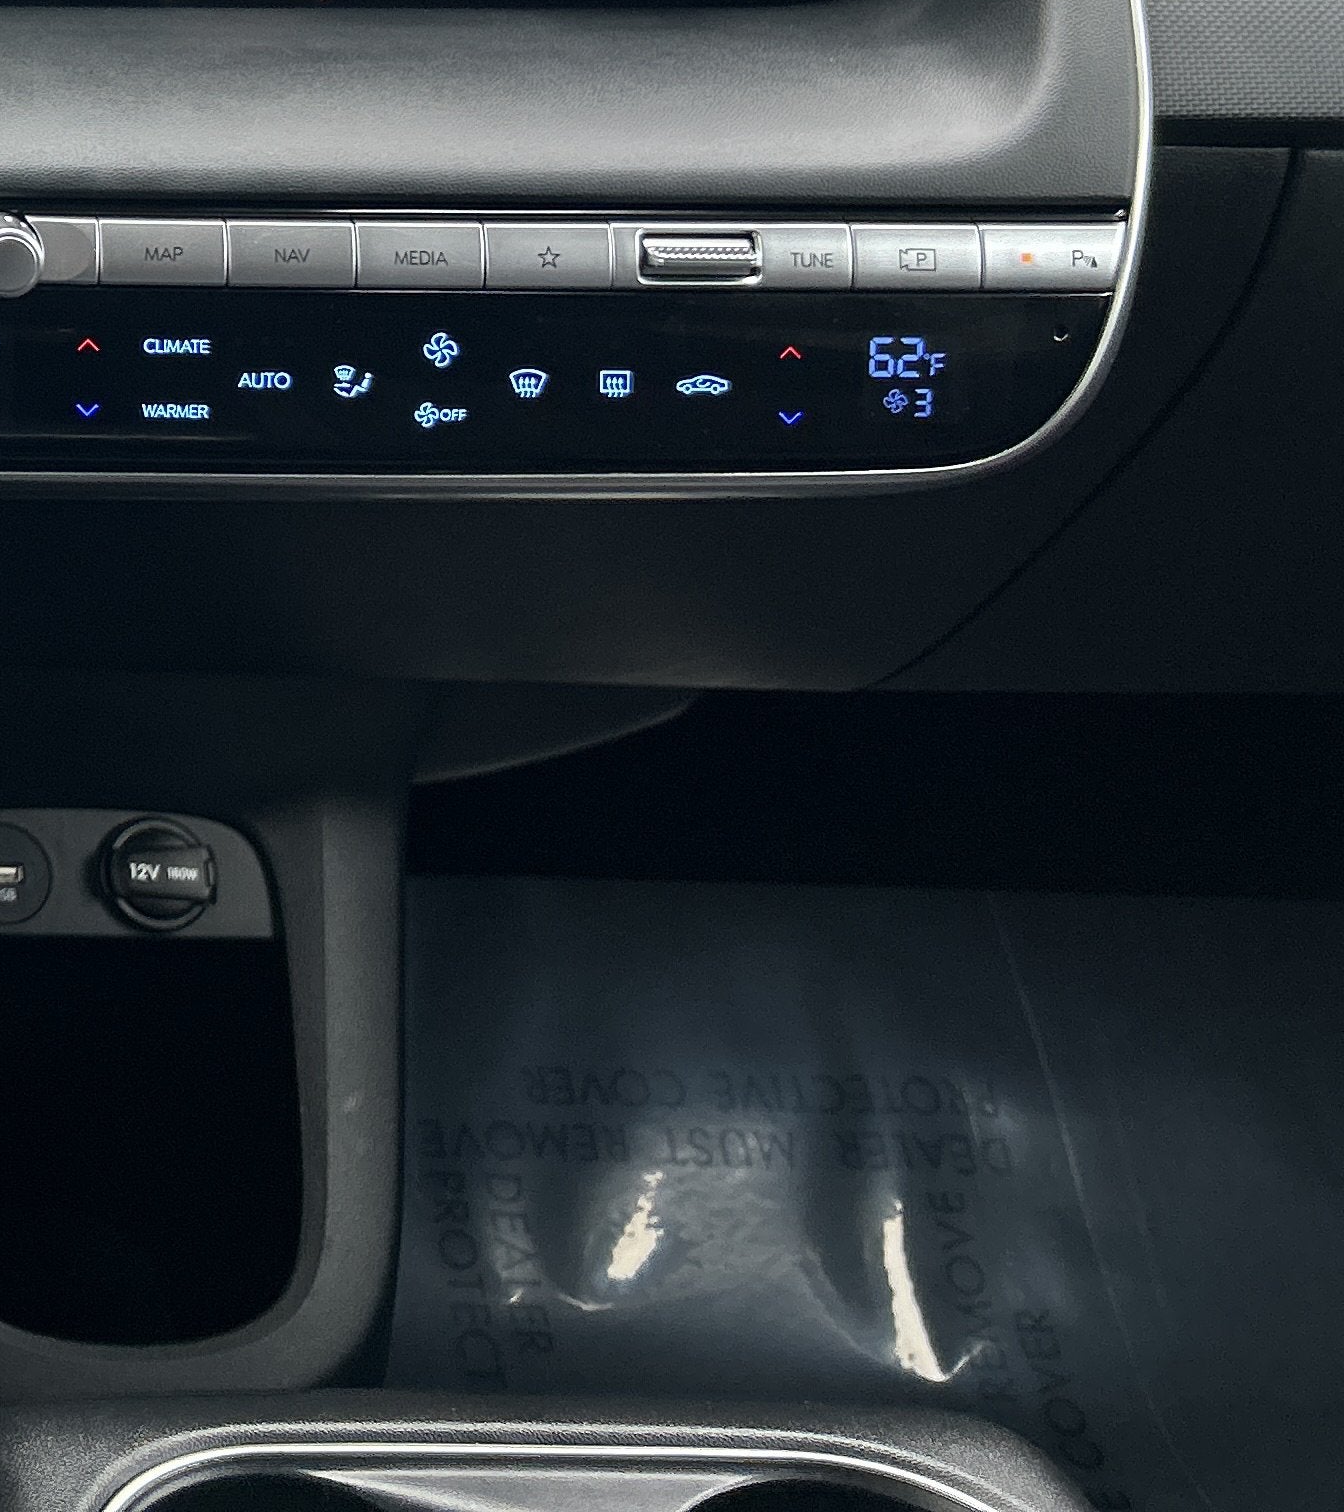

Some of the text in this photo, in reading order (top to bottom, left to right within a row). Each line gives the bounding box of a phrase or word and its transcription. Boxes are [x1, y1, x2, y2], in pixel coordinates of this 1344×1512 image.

[144, 246, 184, 263] MAP
[274, 248, 310, 264] NAV
[394, 250, 449, 267] MEDIA
[790, 252, 834, 268] TUNE
[143, 337, 211, 355] CLIMATE
[238, 371, 293, 390] AUTO
[142, 403, 210, 421] WARMER
[914, 388, 932, 419] 3
[440, 407, 468, 422] OFF
[129, 861, 160, 881] 12V
